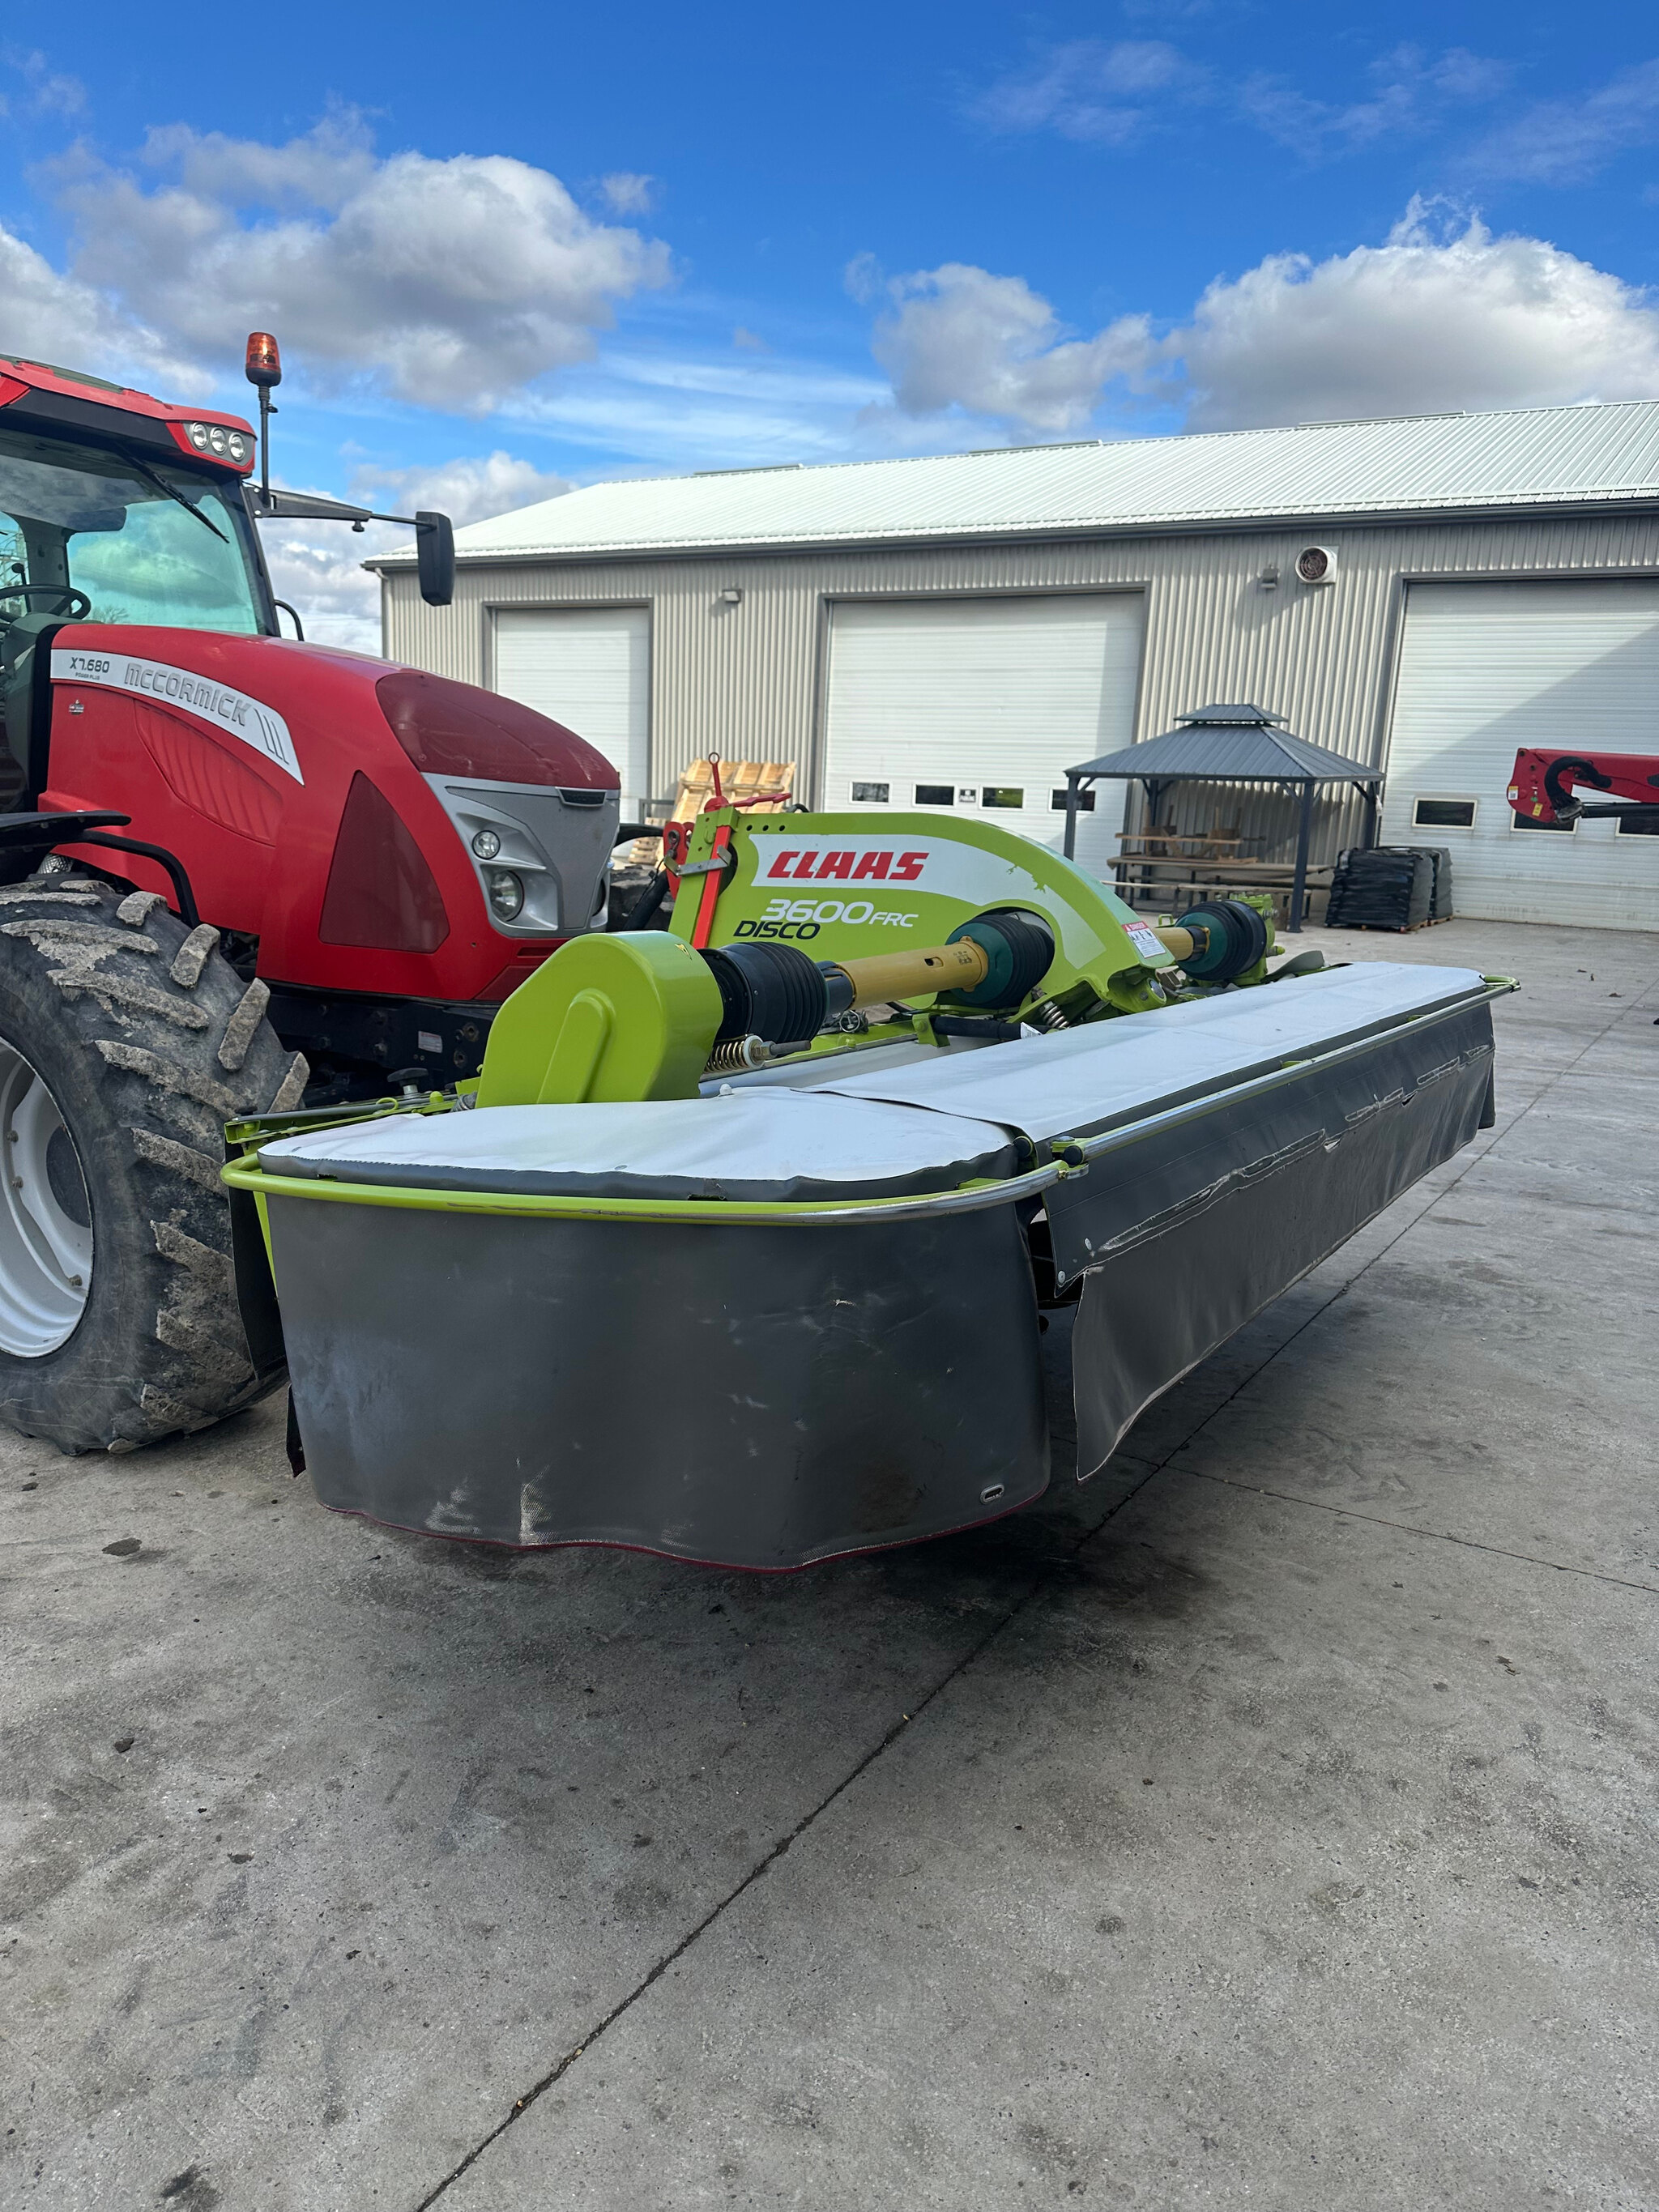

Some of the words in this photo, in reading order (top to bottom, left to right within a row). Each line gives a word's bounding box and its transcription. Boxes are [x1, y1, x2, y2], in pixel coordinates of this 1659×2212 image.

[70, 657, 110, 673] X7.680
[767, 851, 930, 880] CLAAS
[733, 920, 821, 940] DISCO
